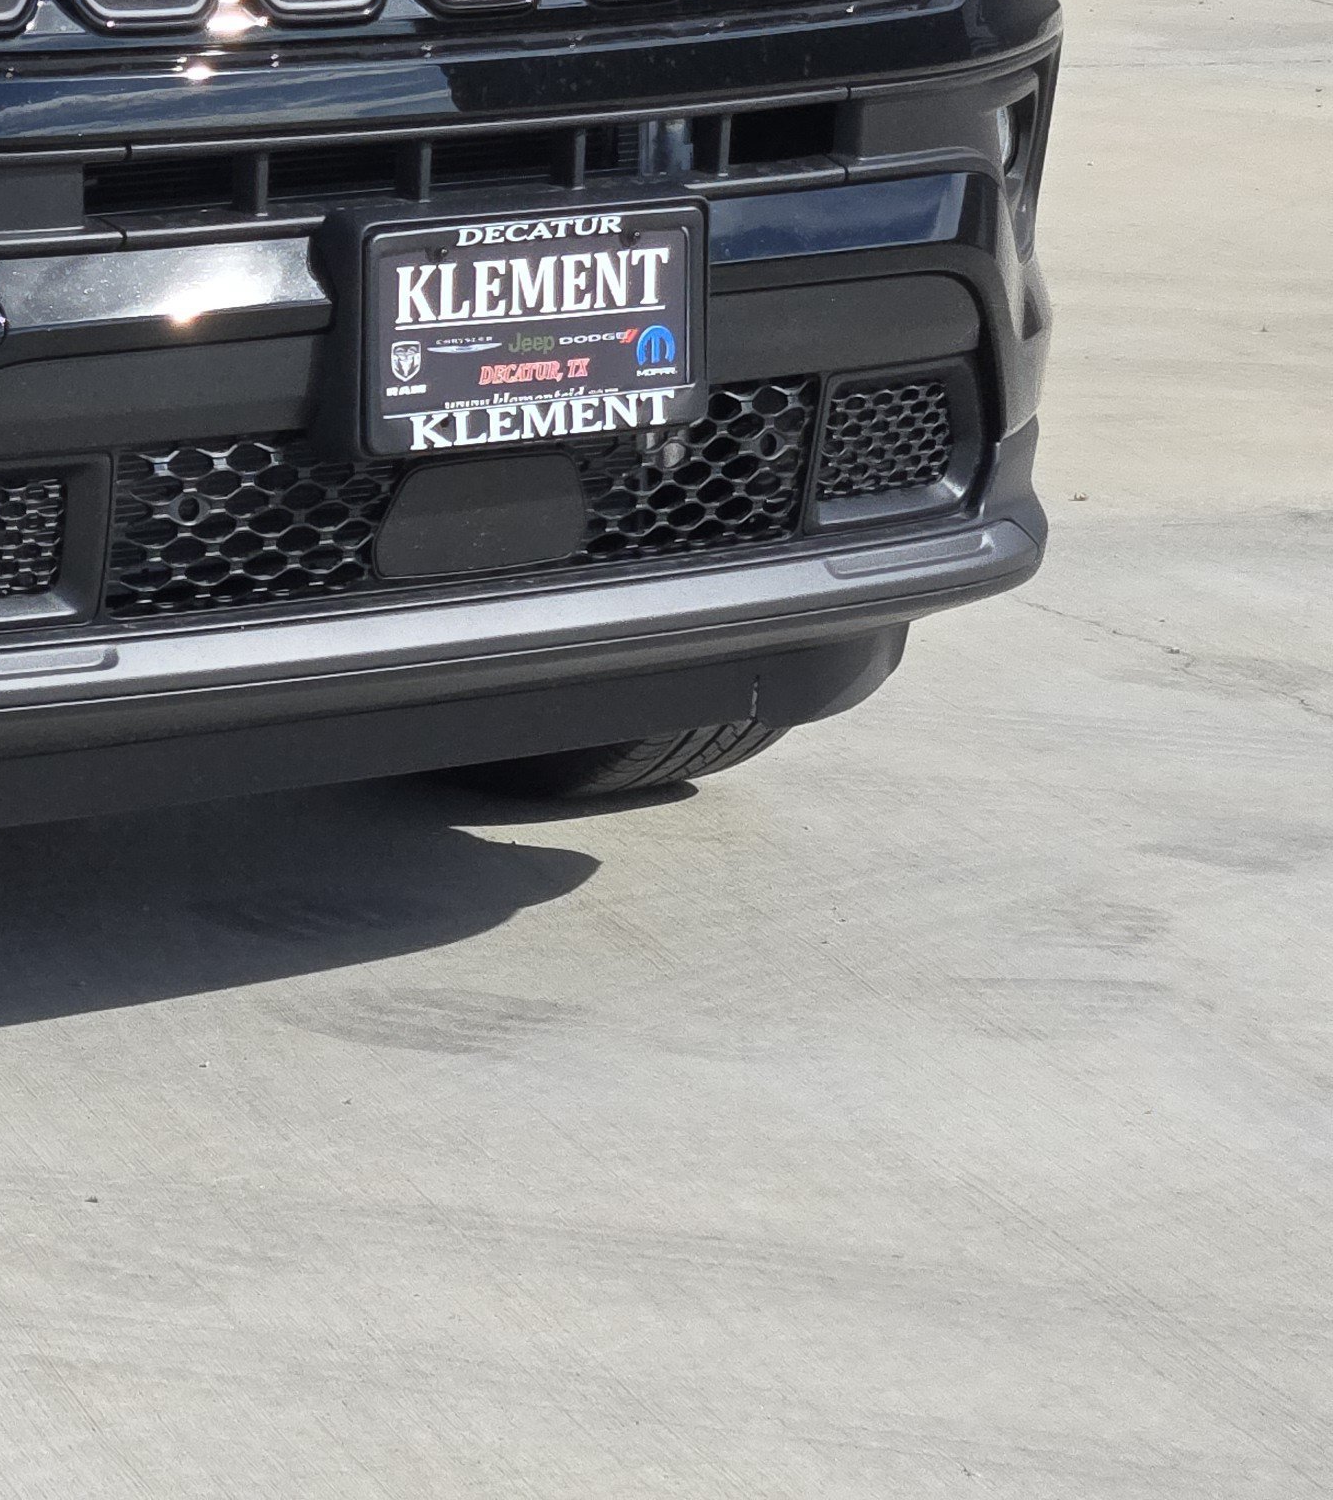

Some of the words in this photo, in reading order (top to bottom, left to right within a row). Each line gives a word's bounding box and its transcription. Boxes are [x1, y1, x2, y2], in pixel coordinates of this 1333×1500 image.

[456, 216, 623, 247] DECATUR
[395, 247, 670, 324] KLEMENT
[508, 332, 555, 354] Jeep
[567, 357, 591, 378] TX
[386, 384, 427, 397] RAM
[410, 390, 674, 450] KLEMENT
